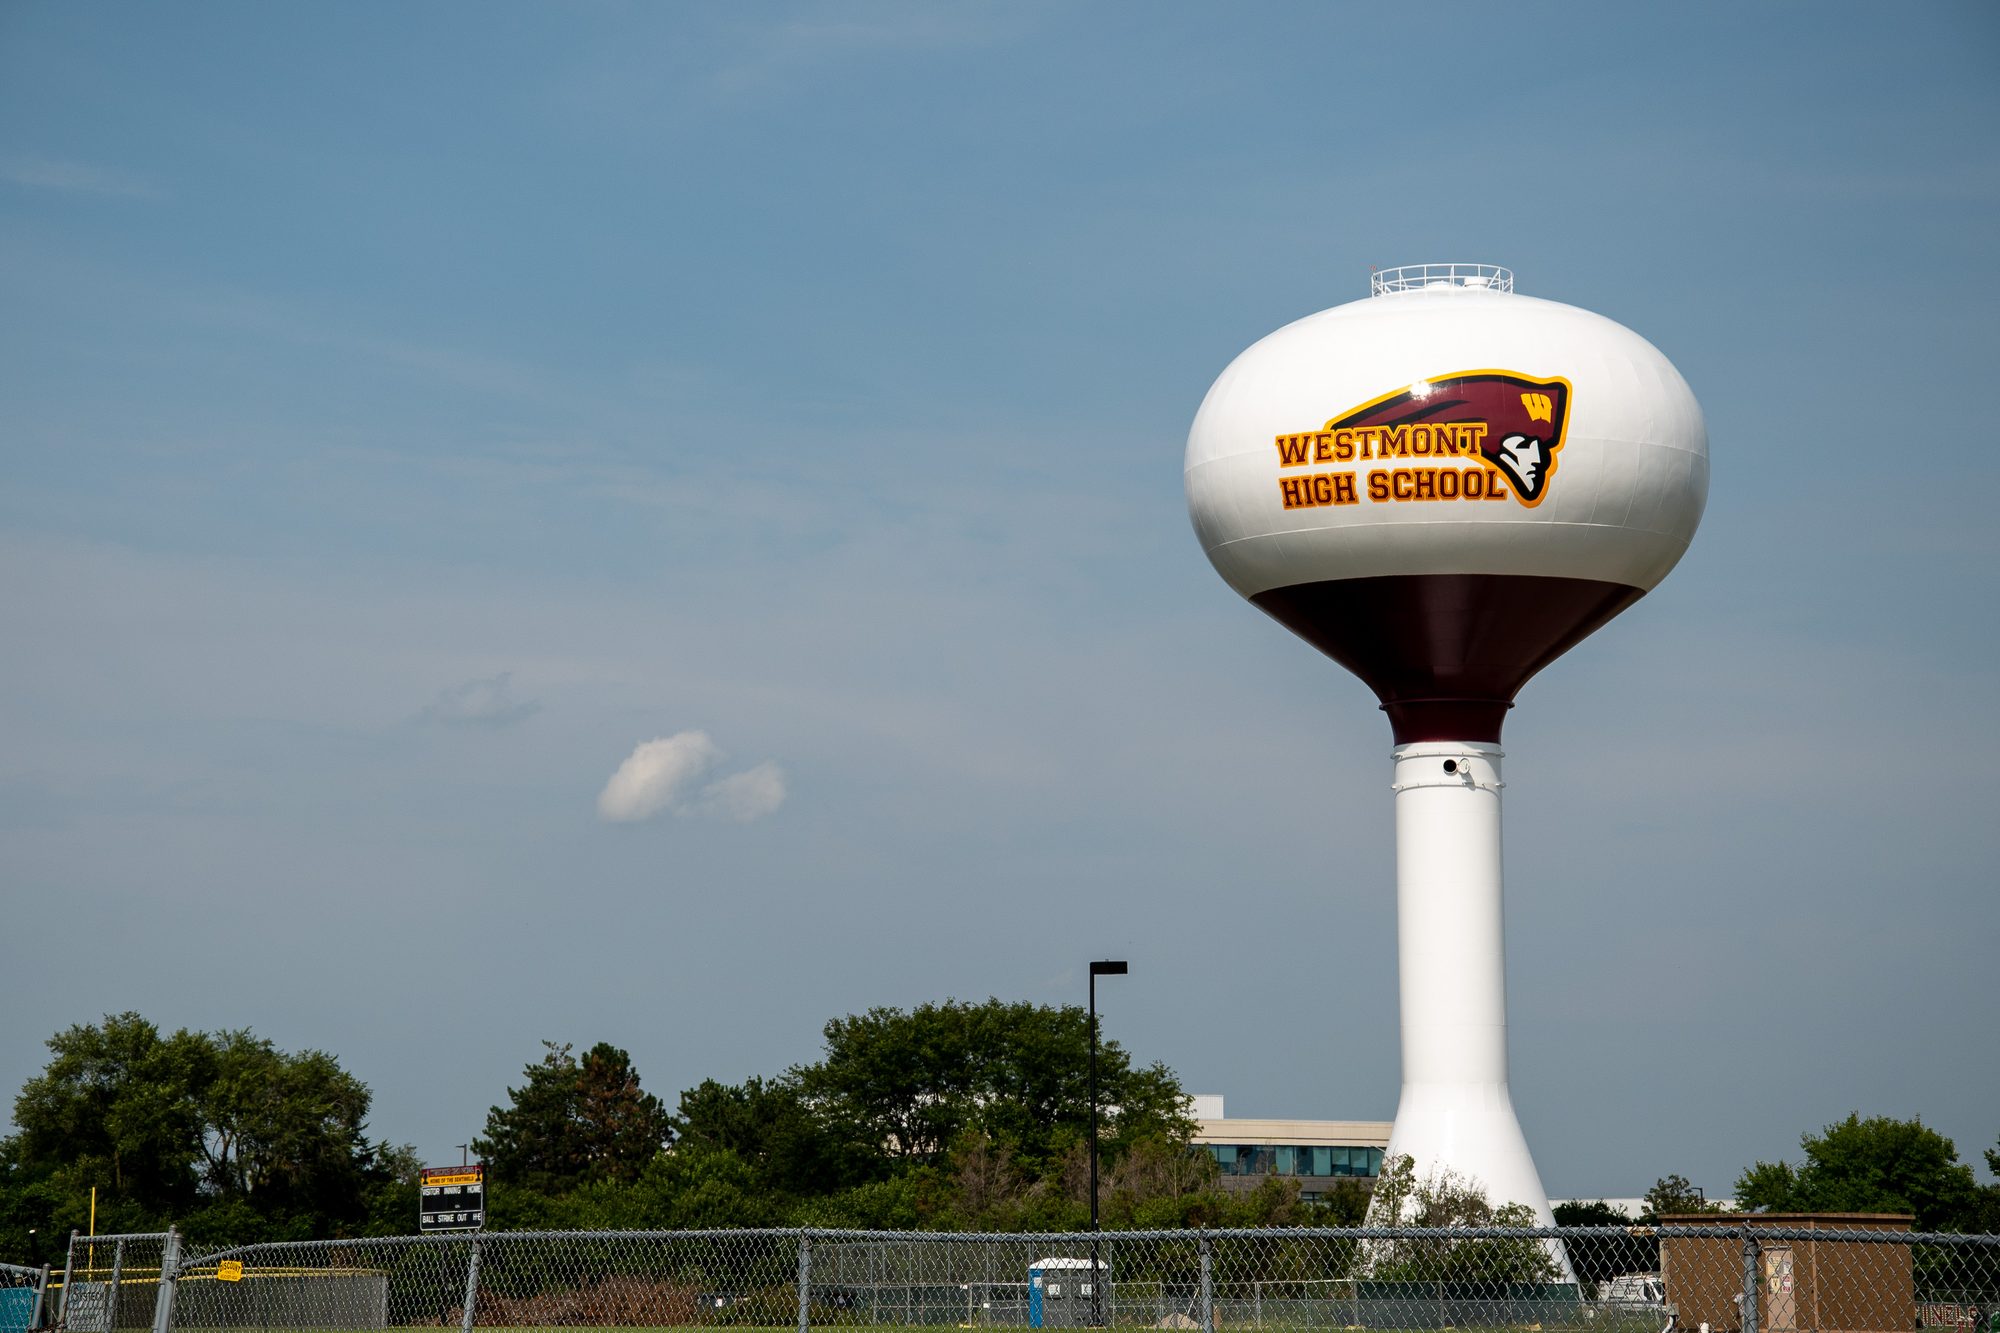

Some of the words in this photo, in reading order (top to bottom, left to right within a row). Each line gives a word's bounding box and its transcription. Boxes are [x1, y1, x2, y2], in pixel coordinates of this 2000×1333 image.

[1276, 423, 1488, 467] WESTMONT
[1279, 471, 1360, 510] HIGH
[1367, 467, 1509, 502] SCHOOL
[423, 1188, 440, 1196] VISITOR
[444, 1187, 461, 1195] INNING
[467, 1185, 481, 1193] HOME
[423, 1215, 435, 1223] BALL
[438, 1214, 454, 1223] STRIKE
[457, 1213, 467, 1221] OUT
